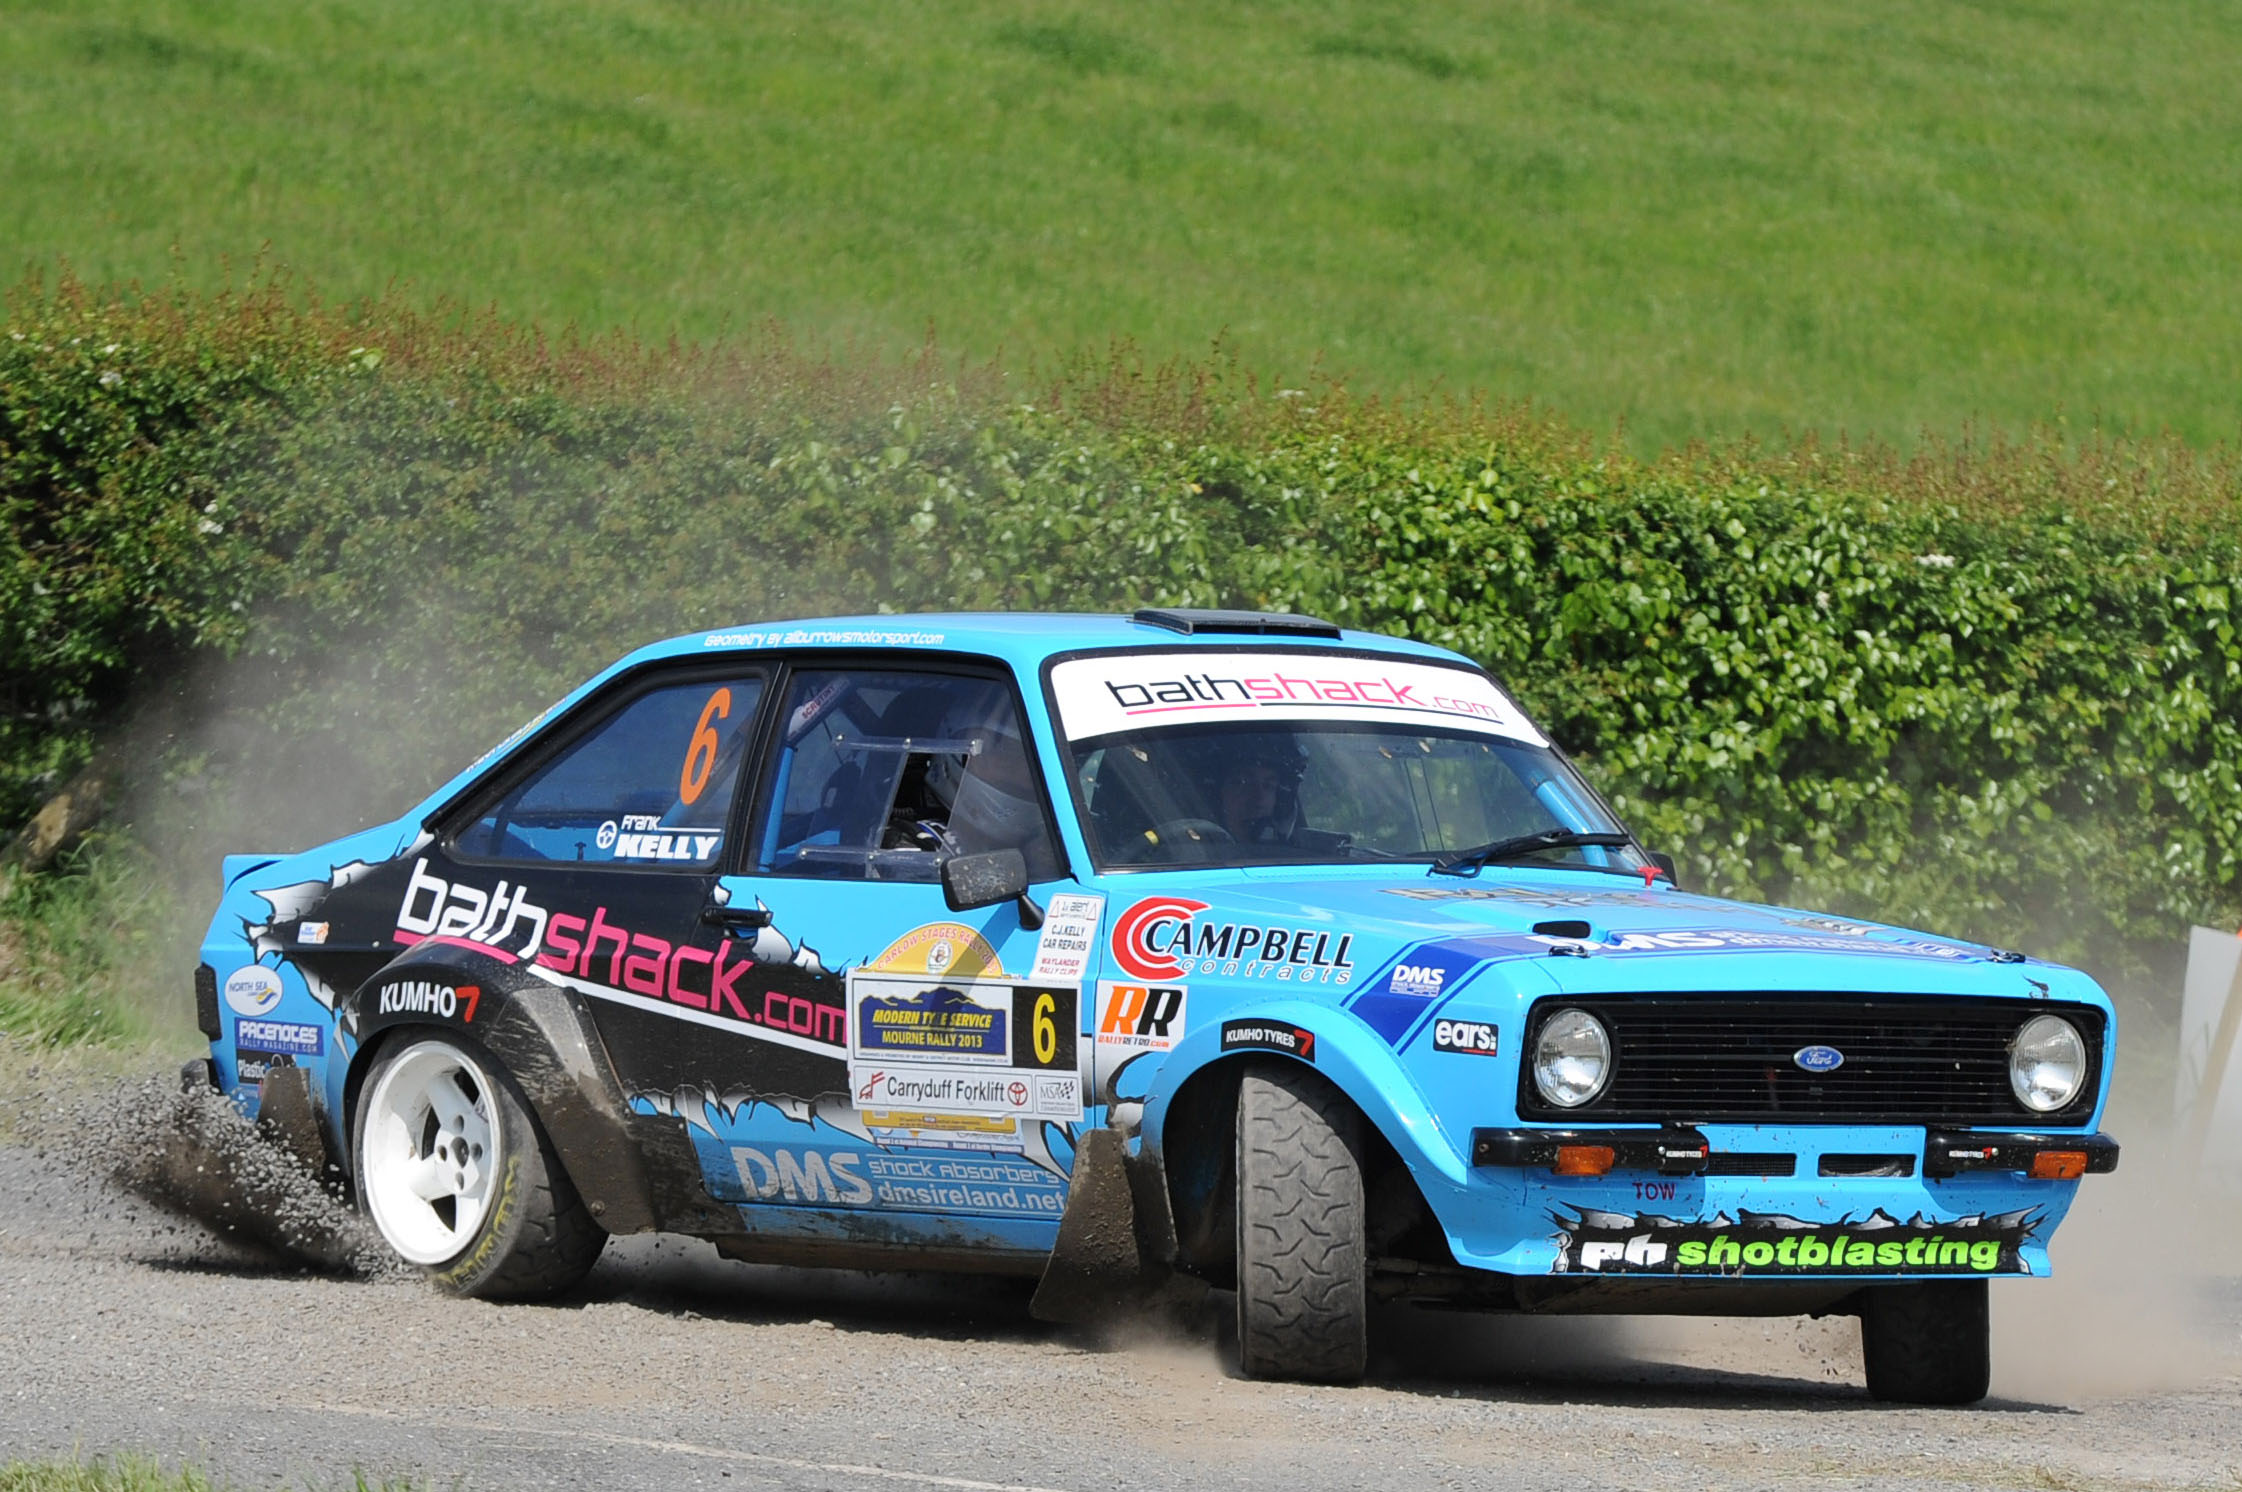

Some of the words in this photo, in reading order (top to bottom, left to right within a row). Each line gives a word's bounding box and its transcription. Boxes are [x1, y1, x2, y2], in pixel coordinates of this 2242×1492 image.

[1105, 673, 1499, 717] bathshack.com
[680, 687, 731, 805] 6
[621, 815, 661, 830] Frank
[614, 834, 719, 860] KELLY
[397, 857, 847, 1044] bathshack.com
[878, 934, 918, 968] CARLOW
[922, 927, 957, 941] STAGES
[1043, 938, 1057, 949] CAR
[1058, 939, 1087, 951] REPAIRS
[1146, 919, 1353, 968] CAMPBELL
[1180, 957, 1351, 984] contracts
[1393, 965, 1445, 985] DMS
[229, 981, 253, 992] NORTH
[255, 981, 268, 991] SEA
[379, 981, 456, 1018] KUMHO
[873, 1009, 919, 1025] MODERN
[949, 1013, 992, 1028] SERVICE
[1100, 985, 1183, 1037] RR
[239, 1020, 318, 1044] PACENOTES
[882, 1031, 924, 1045] MOURNE
[926, 1033, 957, 1047] RALLY
[958, 1034, 982, 1048] 2013
[1032, 993, 1056, 1064] 6
[1226, 1029, 1262, 1043] KUMHO
[1264, 1029, 1295, 1048] TYRES
[240, 1038, 262, 1047] RALLY
[1806, 1051, 1833, 1065] Ford
[887, 1076, 952, 1104] Carryduff
[956, 1080, 1005, 1102] Forklift
[731, 1147, 874, 1204] DMS
[869, 1158, 940, 1178] shock
[878, 1180, 1066, 1212] dmsireland.net
[1631, 1182, 1676, 1201] TOW
[1676, 1235, 2000, 1271] shotblasting
